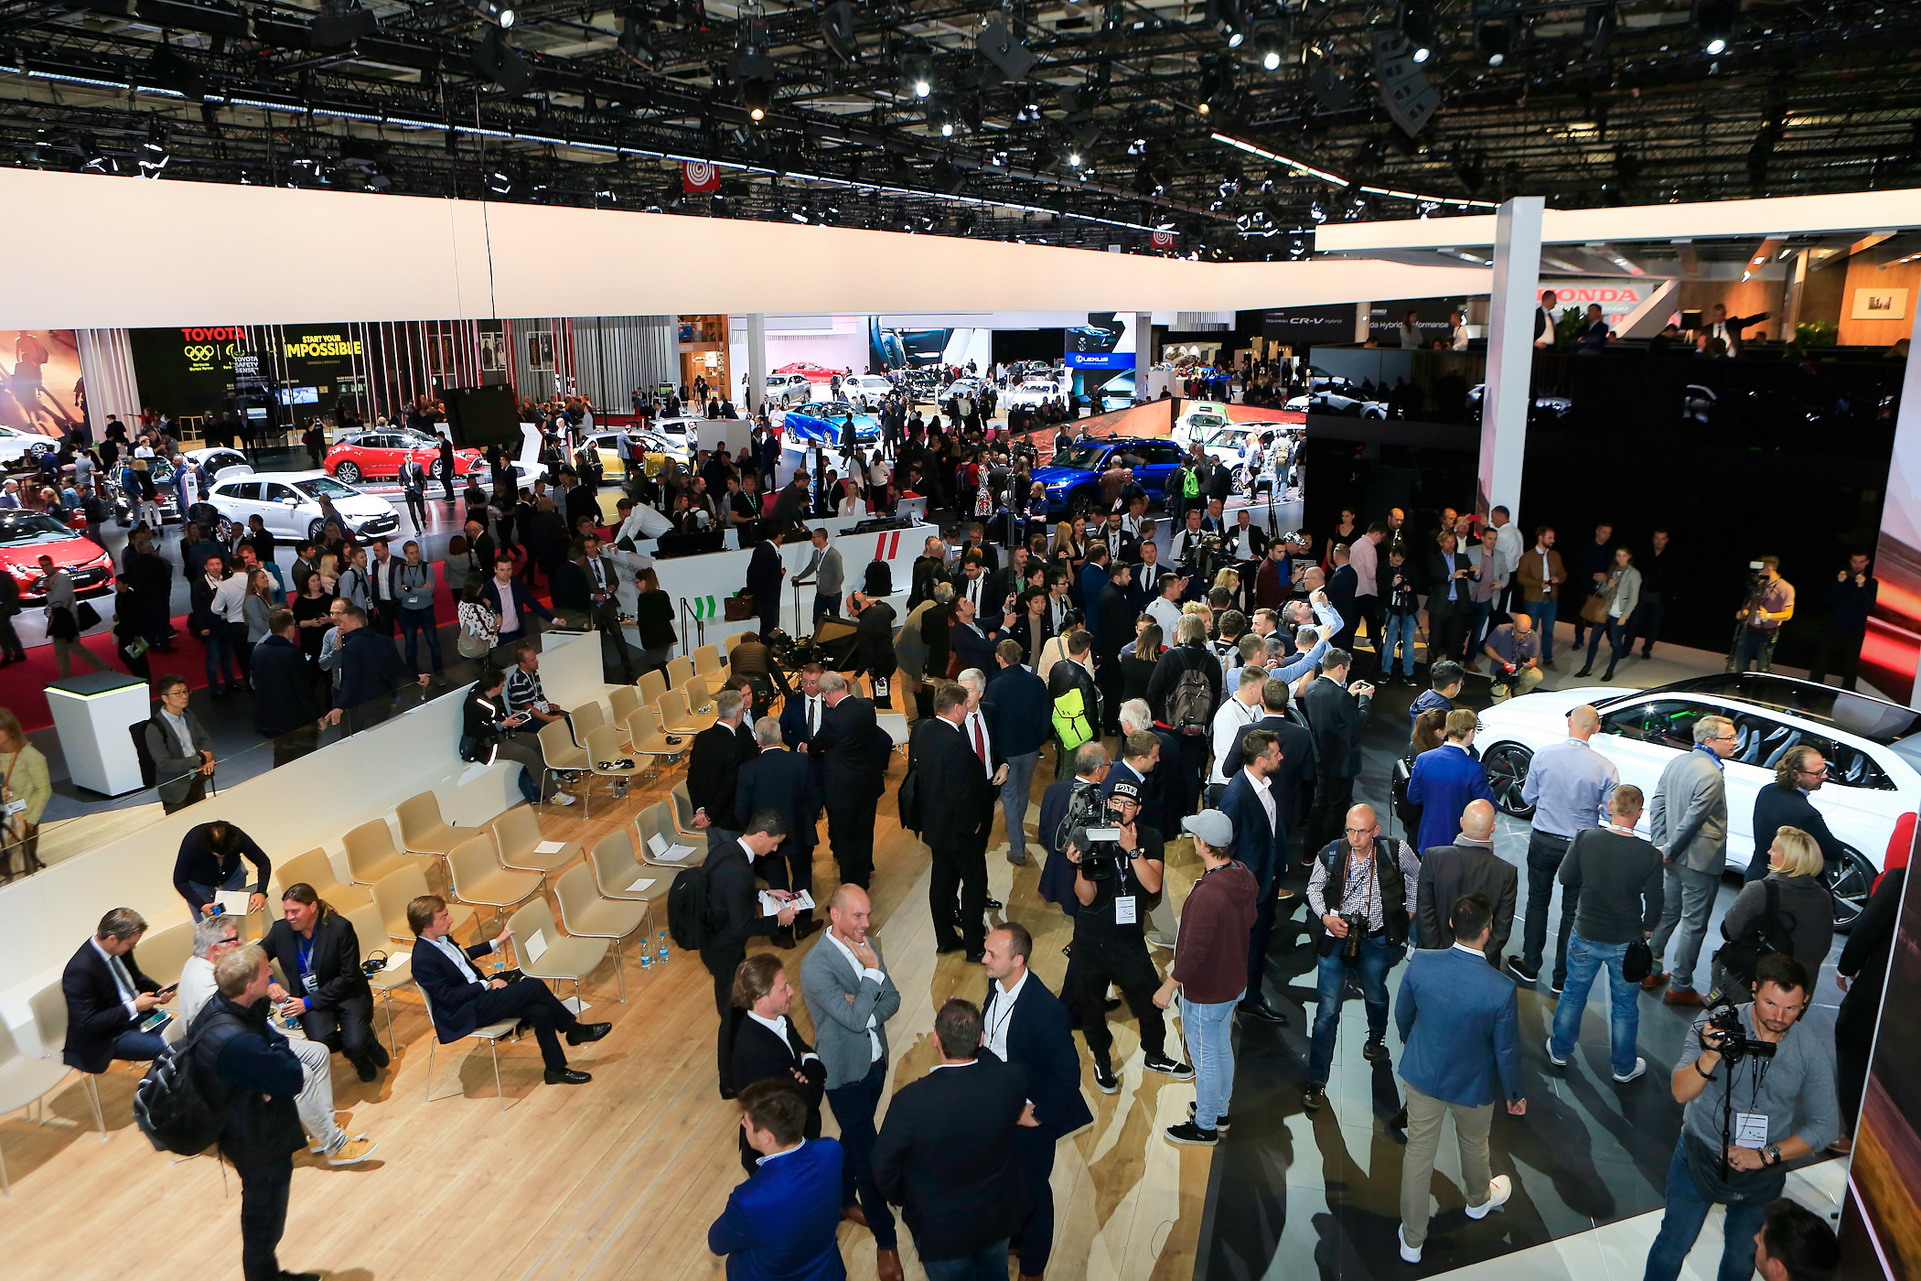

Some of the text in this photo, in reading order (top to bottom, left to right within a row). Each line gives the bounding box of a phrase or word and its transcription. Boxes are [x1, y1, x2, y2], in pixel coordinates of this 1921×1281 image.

[1380, 321, 1402, 330] Hybrid
[181, 327, 246, 341] TOYOTA
[302, 334, 341, 343] START YOUR
